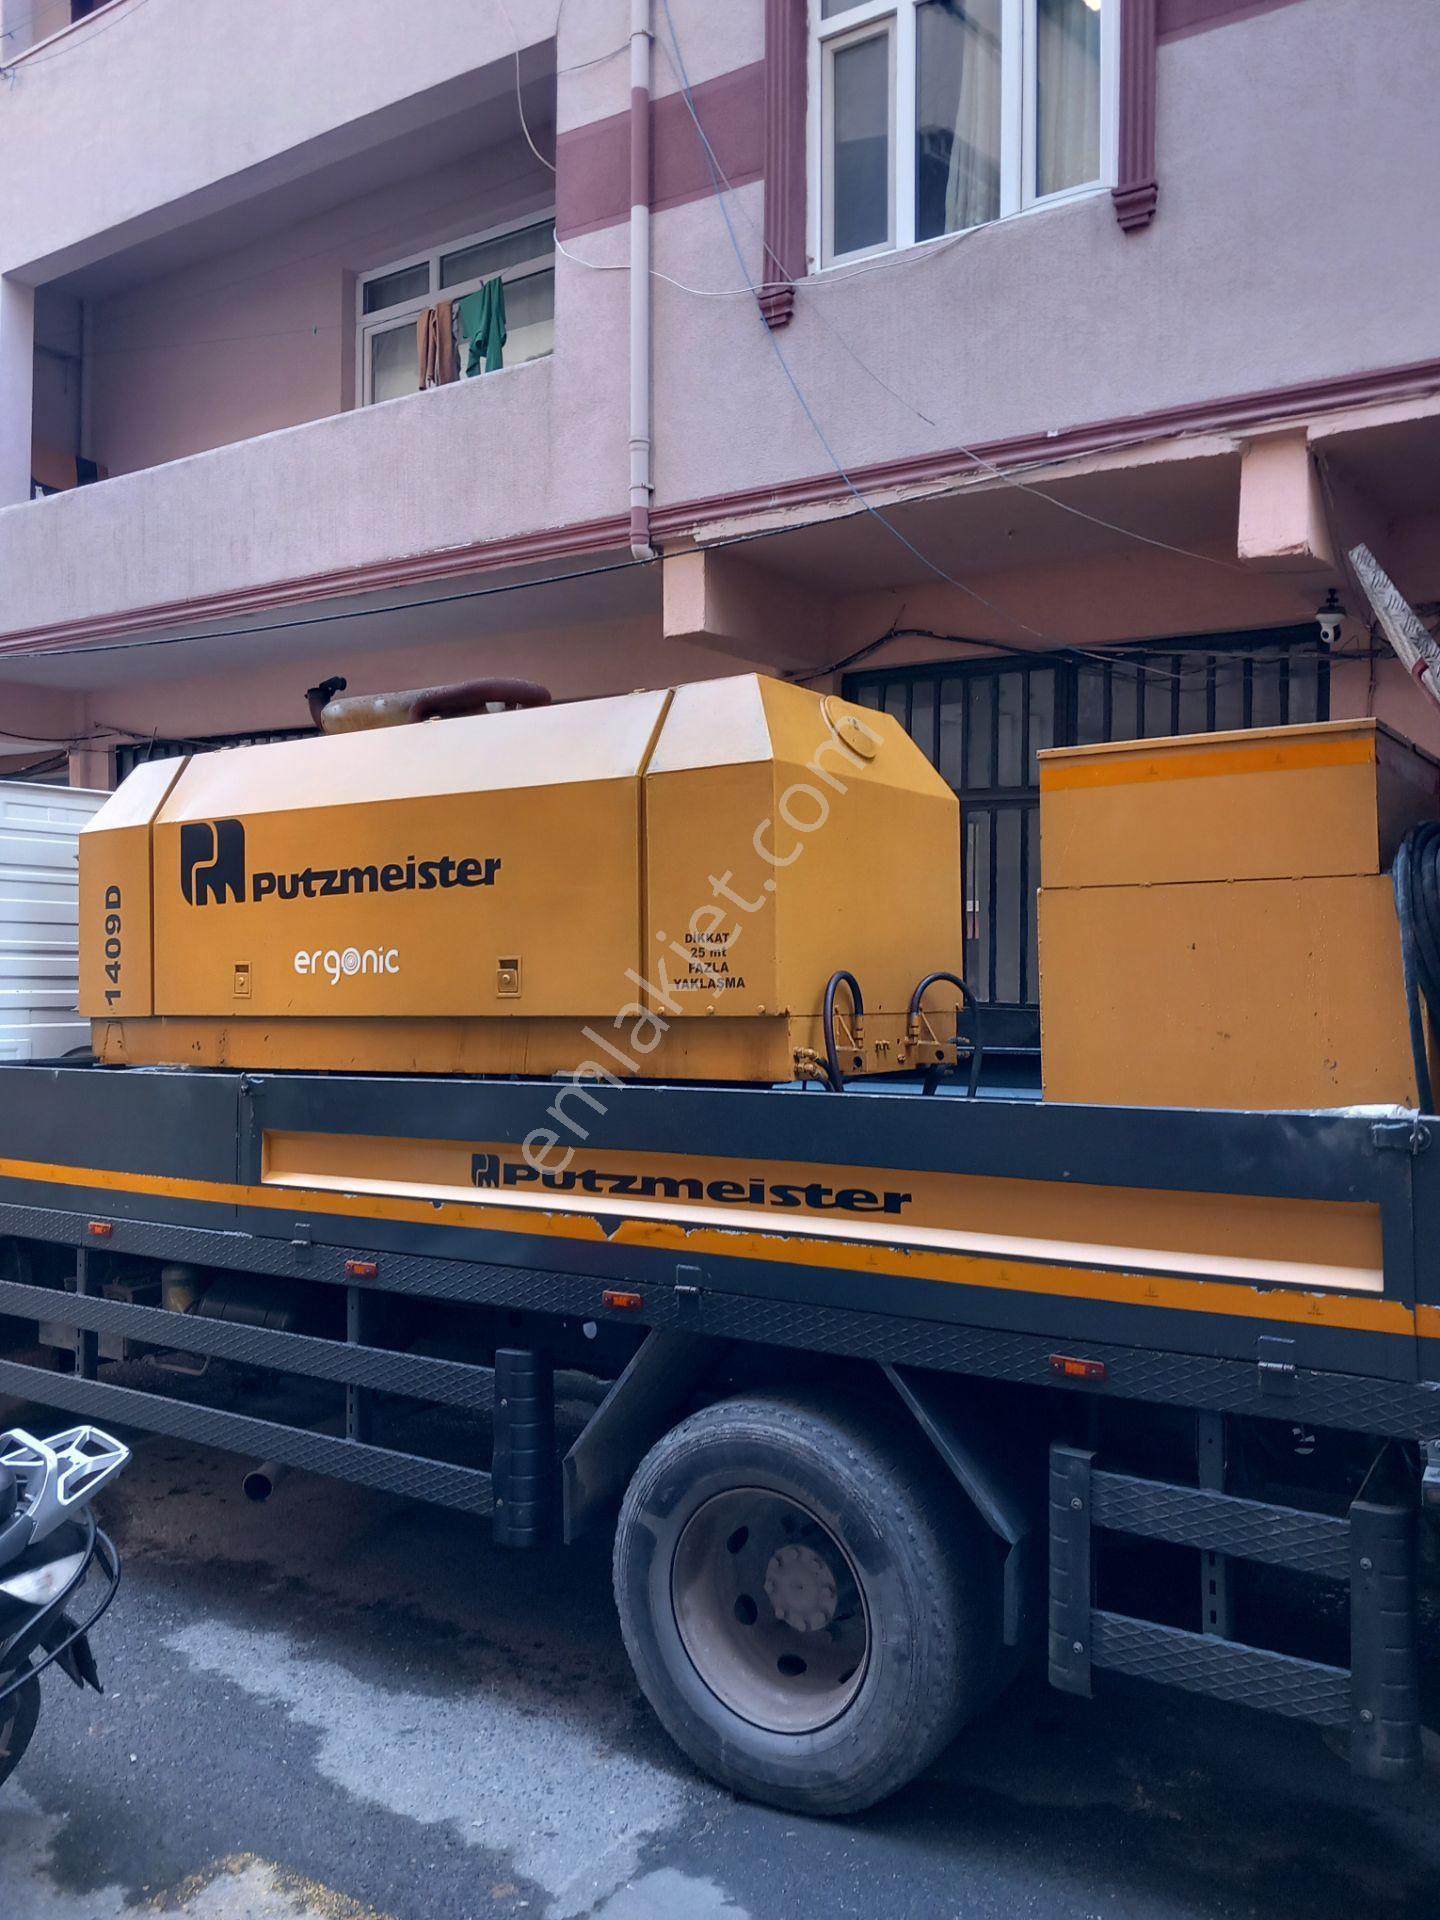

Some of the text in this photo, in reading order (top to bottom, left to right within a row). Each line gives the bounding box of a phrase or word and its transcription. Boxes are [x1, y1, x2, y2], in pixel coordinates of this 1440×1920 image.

[253, 855, 501, 902] Putzmeister
[105, 885, 121, 1006] 1409D
[690, 947, 705, 958] 25
[294, 946, 400, 985] ergonic
[674, 977, 745, 991] YAKLAŞMA
[688, 962, 729, 973] FAZLA
[503, 1163, 912, 1214] Putzmeister
